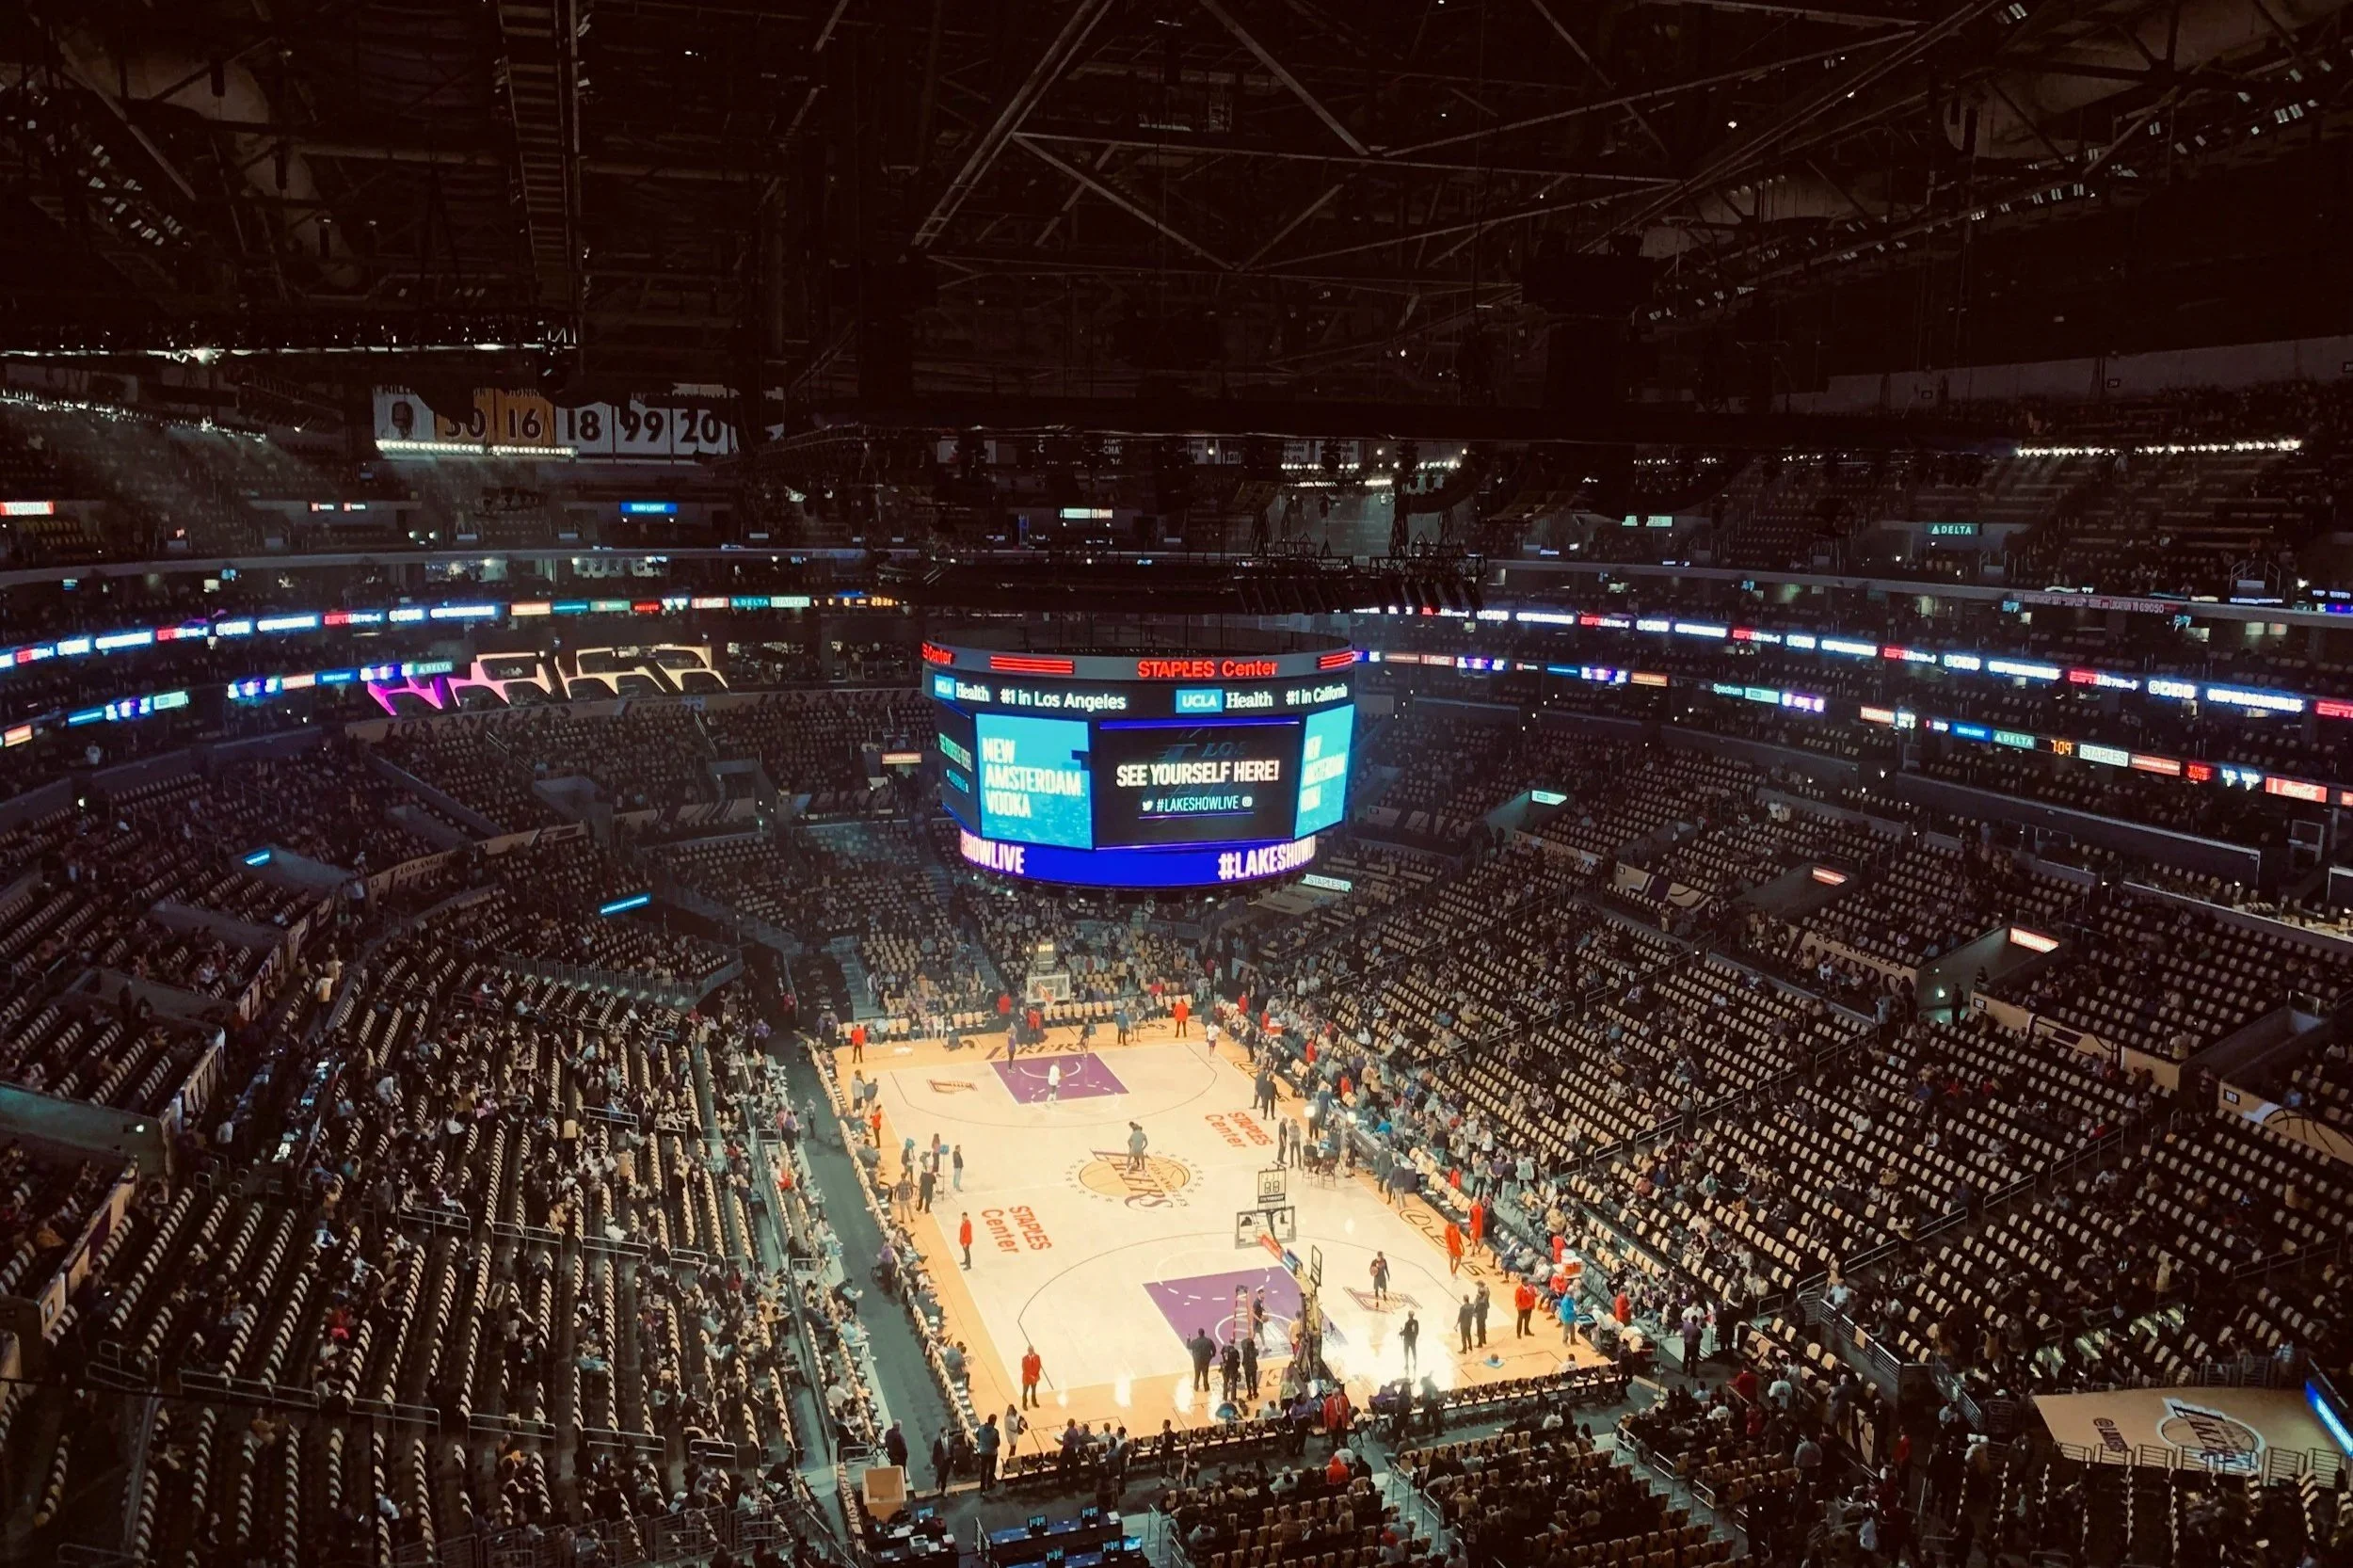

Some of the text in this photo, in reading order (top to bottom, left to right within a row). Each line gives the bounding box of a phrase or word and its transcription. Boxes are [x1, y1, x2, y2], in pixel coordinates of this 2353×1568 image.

[508, 408, 541, 439] 16
[567, 409, 600, 441] 18
[625, 410, 664, 442] 99
[680, 408, 722, 443] 20
[1941, 525, 1972, 535] DELTA
[2139, 602, 2164, 613] 69050
[1138, 661, 1278, 678] STAPLES Center
[955, 682, 989, 702] Health
[1000, 688, 1016, 704] #1
[1018, 690, 1031, 705] in
[1034, 692, 1060, 708] Los
[1064, 693, 1127, 712] Angeles
[1182, 683, 1348, 709] UCLA Health #1 in California
[1713, 683, 1742, 696] Spectrum
[982, 738, 1016, 764] NEW
[2003, 734, 2033, 746] DELTA
[2081, 744, 2127, 764] STAPLES
[984, 763, 1081, 796] AMSTERDAM
[1116, 760, 1280, 787] SEE YOURSELF HERE!
[985, 790, 1032, 818] VODKA
[1157, 795, 1239, 812] #LAKESHOWLIVE
[1308, 875, 1342, 890] STAPLES
[1205, 1114, 1247, 1147] Center
[1227, 1112, 1273, 1145] STAPLES
[981, 1209, 1020, 1253] Center
[1009, 1206, 1052, 1250] STAPLES
